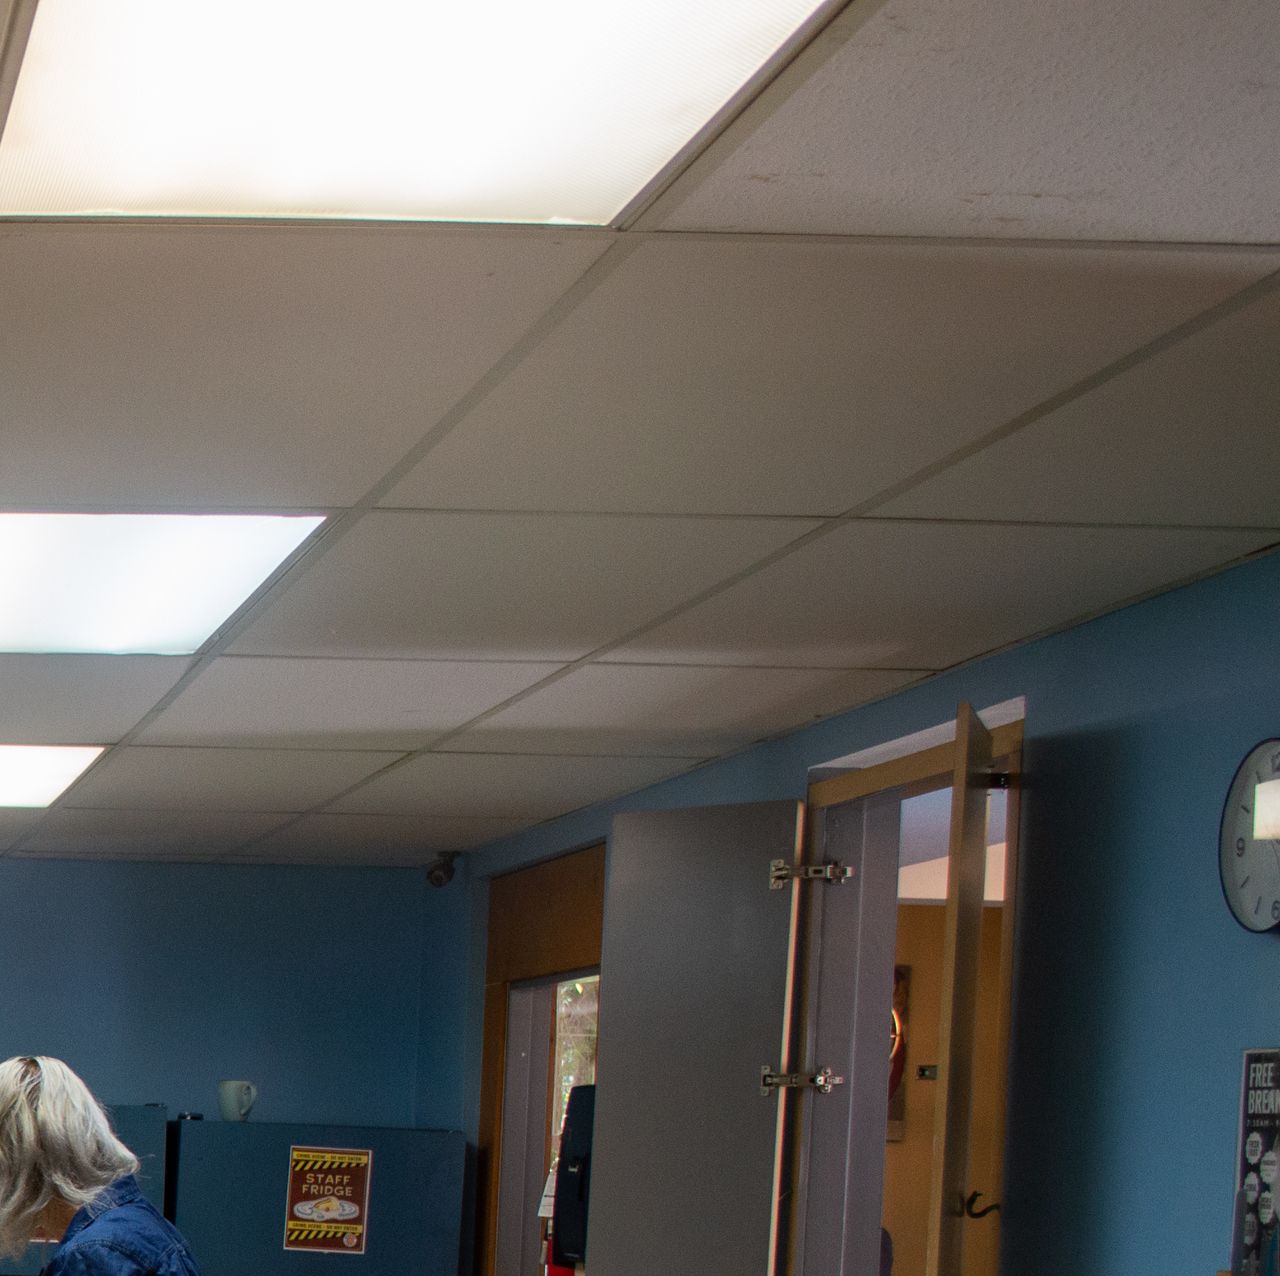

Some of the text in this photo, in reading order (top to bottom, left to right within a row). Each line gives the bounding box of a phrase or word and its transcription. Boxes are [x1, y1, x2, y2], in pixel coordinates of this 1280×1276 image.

[1236, 837, 1245, 857] 9
[1250, 1063, 1274, 1088] FREE
[306, 1173, 350, 1185] STAFF
[302, 1184, 353, 1196] FRIDGE
